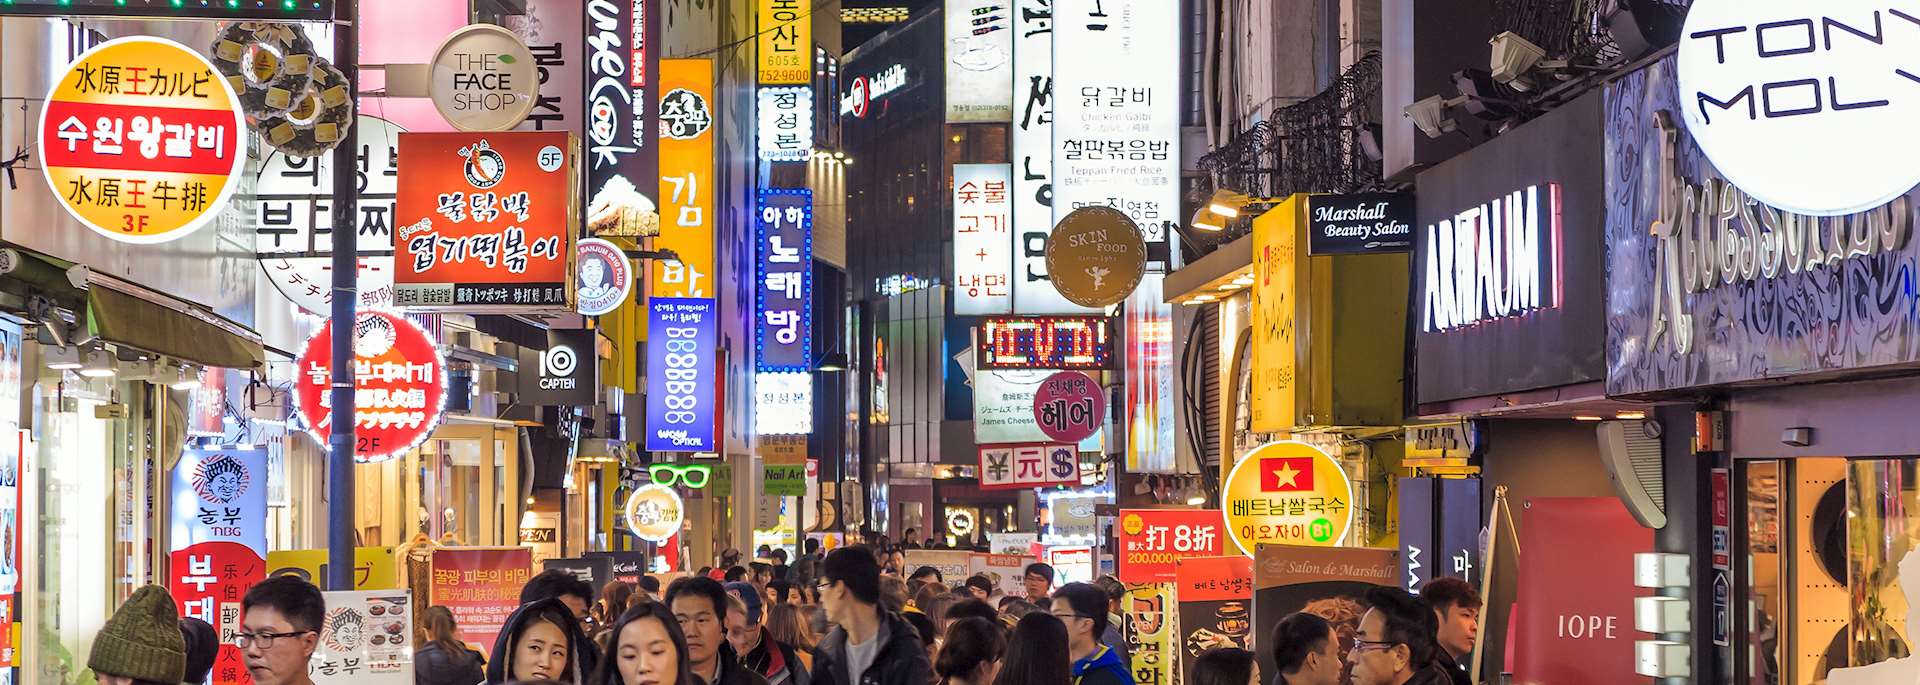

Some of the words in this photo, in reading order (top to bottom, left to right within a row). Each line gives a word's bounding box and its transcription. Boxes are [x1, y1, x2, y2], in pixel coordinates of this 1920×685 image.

[454, 53, 497, 71] THE
[74, 62, 213, 99] 水原王カルビ
[453, 73, 512, 91] FACE
[453, 93, 516, 111] SHOP
[1081, 86, 1151, 108] 닭갈비
[773, 91, 802, 150] 정성본
[1080, 112, 1123, 122] Chicken
[57, 116, 226, 160] 수원왕갈비
[541, 152, 561, 167] 5F
[1063, 139, 1171, 161] 철판볶음밥
[1071, 165, 1108, 176] Teppan
[1139, 165, 1163, 175] Rice
[68, 175, 208, 213] 水原王牛排
[957, 179, 1006, 204] 숯불
[436, 191, 531, 223] 불닭발
[1314, 201, 1389, 223] Marshall
[121, 214, 151, 234] 3F
[762, 206, 806, 231] 아하
[958, 213, 1006, 233] 고기
[1068, 229, 1109, 248] SKIN
[1324, 223, 1371, 241] Beauty
[1372, 219, 1410, 238] Salon
[408, 226, 560, 274] 엽기떡볶이
[1096, 242, 1128, 253] FOOD
[1423, 184, 1541, 334] ARITAUM
[764, 235, 805, 345] 노래방
[959, 273, 1008, 298] 냉면
[538, 377, 577, 390] CAPTEN
[982, 417, 1006, 425] James
[1041, 398, 1095, 432] 헤어
[357, 436, 381, 453] 2F
[657, 429, 688, 440] WOW
[672, 437, 704, 447] OPTICAL
[764, 467, 785, 481] Nail
[787, 468, 804, 480] Art
[1018, 450, 1043, 479] 元
[197, 506, 243, 526] 놀부
[1232, 496, 1345, 517] 베트남쌀국수
[1241, 523, 1305, 541] 아오자이
[1127, 552, 1173, 565] 200,000
[434, 568, 462, 586] 꿀광
[463, 567, 503, 585] 피부의
[503, 567, 530, 584] 비밀
[1286, 560, 1321, 574] Salon
[1322, 561, 1338, 576] de
[1338, 563, 1396, 579] Marshall
[1557, 615, 1618, 639] IOPE
[317, 657, 361, 676] 놀부
